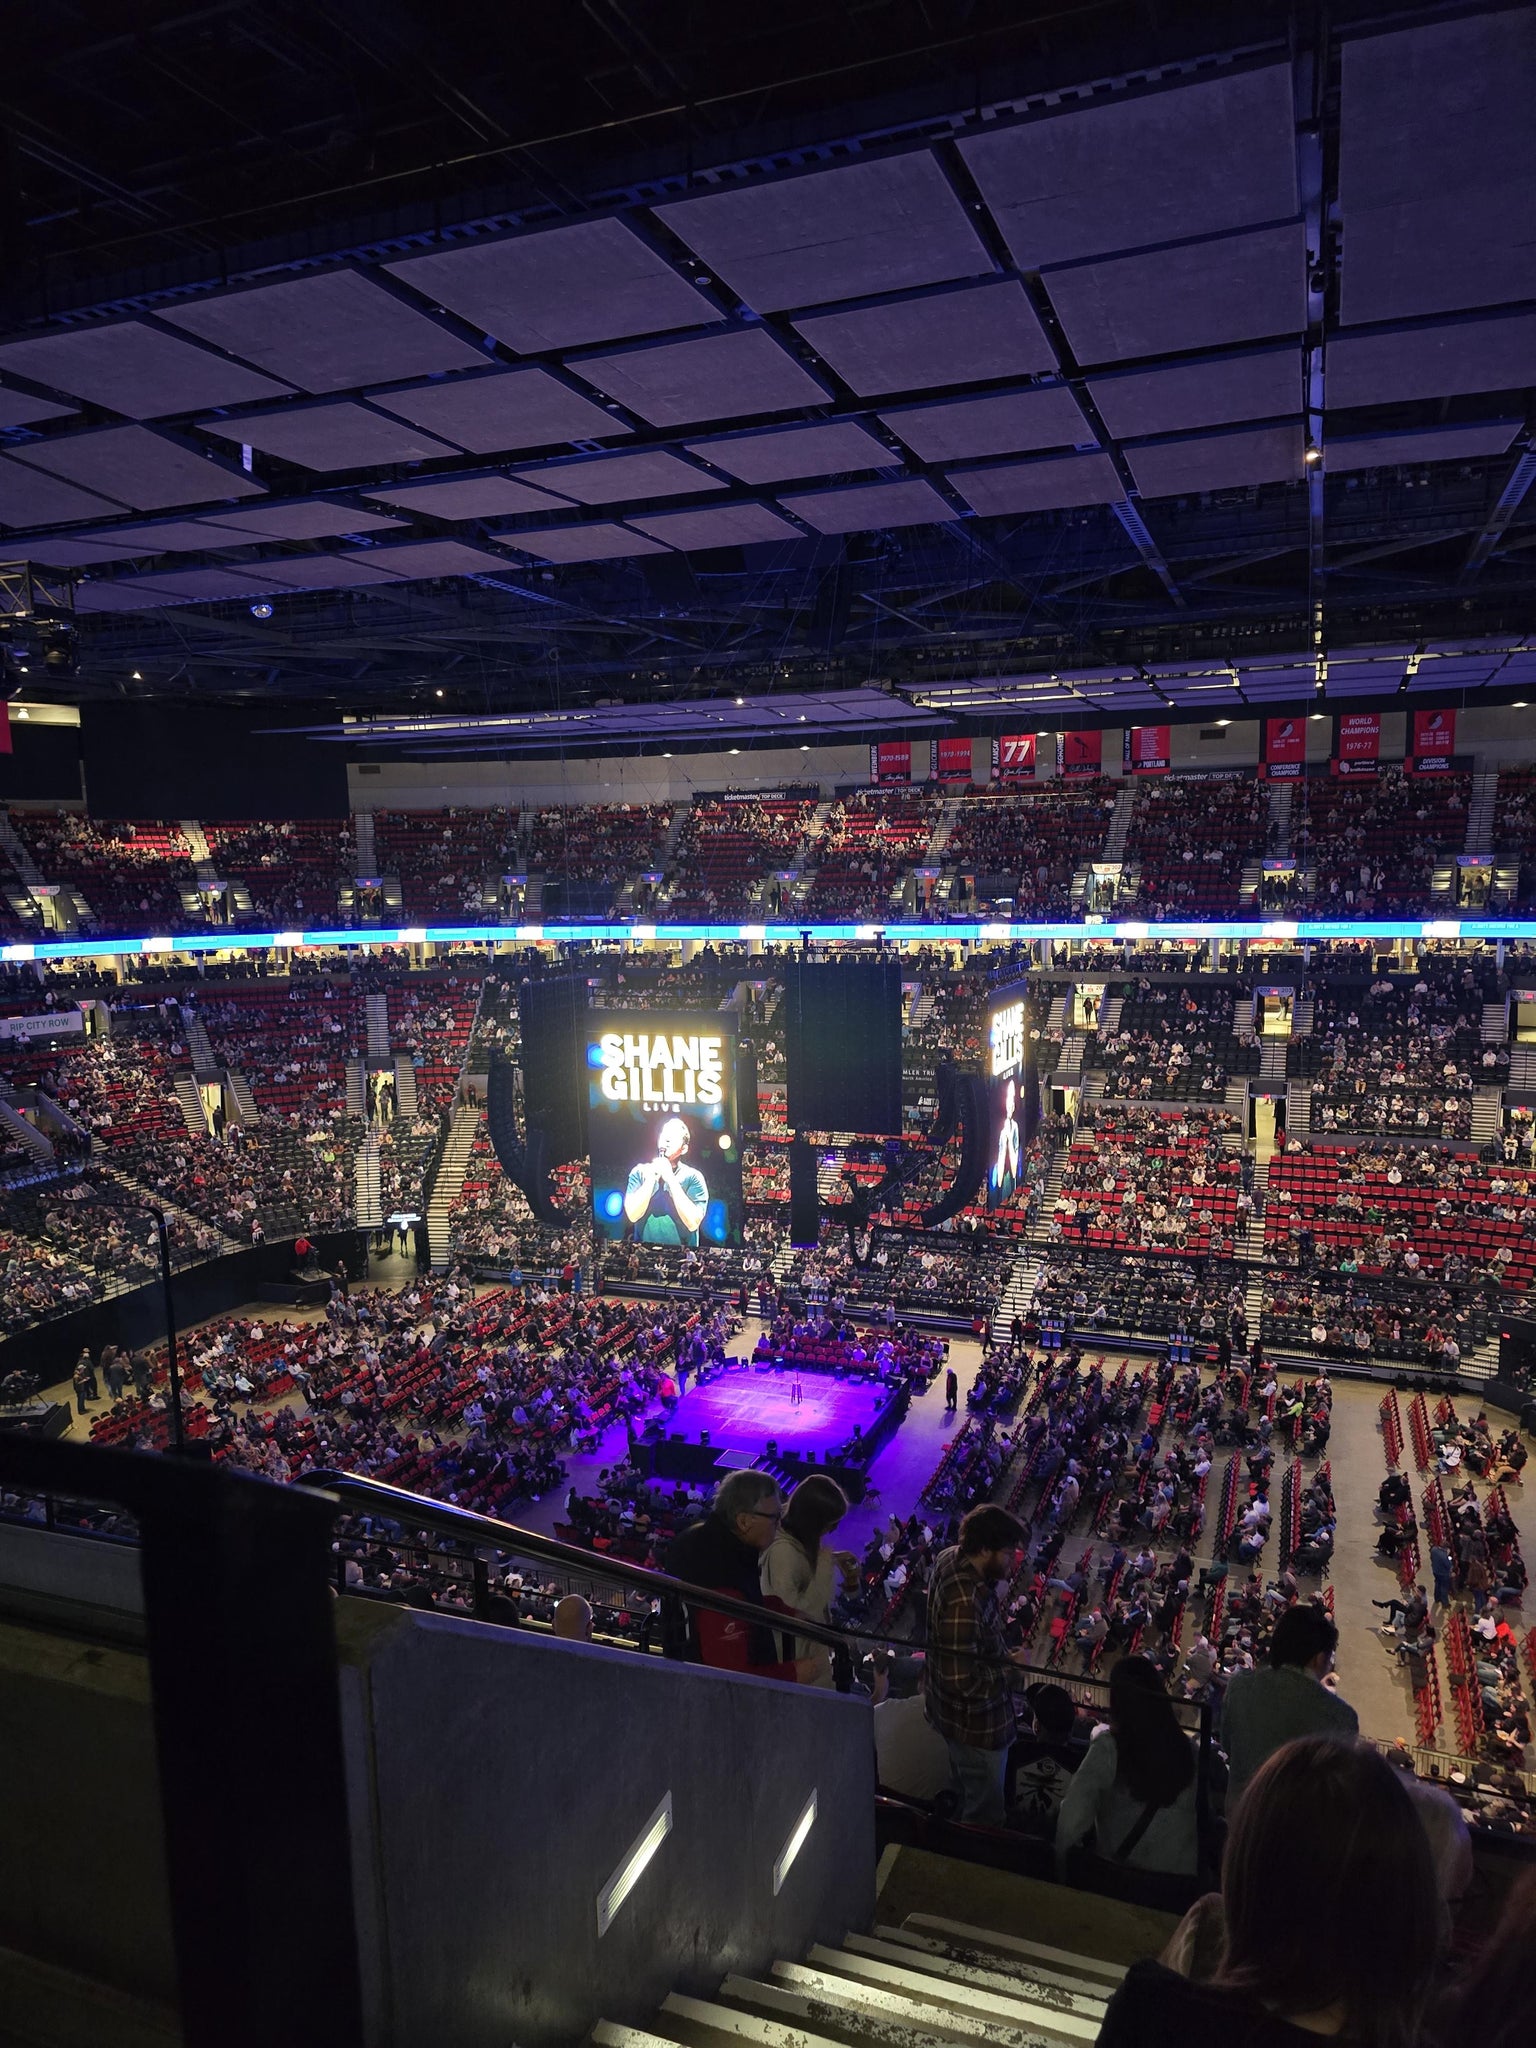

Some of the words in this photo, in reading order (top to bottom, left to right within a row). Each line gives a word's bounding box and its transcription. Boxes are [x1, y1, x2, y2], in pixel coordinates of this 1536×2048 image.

[1349, 717, 1373, 726] WORLD
[1340, 726, 1379, 735] CHAMPIONS
[992, 739, 1000, 765] RAMSAY
[1003, 740, 1030, 762] 77
[870, 745, 878, 774] WEINBERG
[1143, 760, 1165, 768] PORTLAND
[724, 793, 760, 801] ticketmaster
[10, 1023, 25, 1032] RIP
[26, 1020, 46, 1030] CITY
[48, 1018, 69, 1027] ROW
[600, 1033, 723, 1071] SHANE
[601, 1066, 723, 1104] GILLIS
[643, 1102, 681, 1113] LIVE
